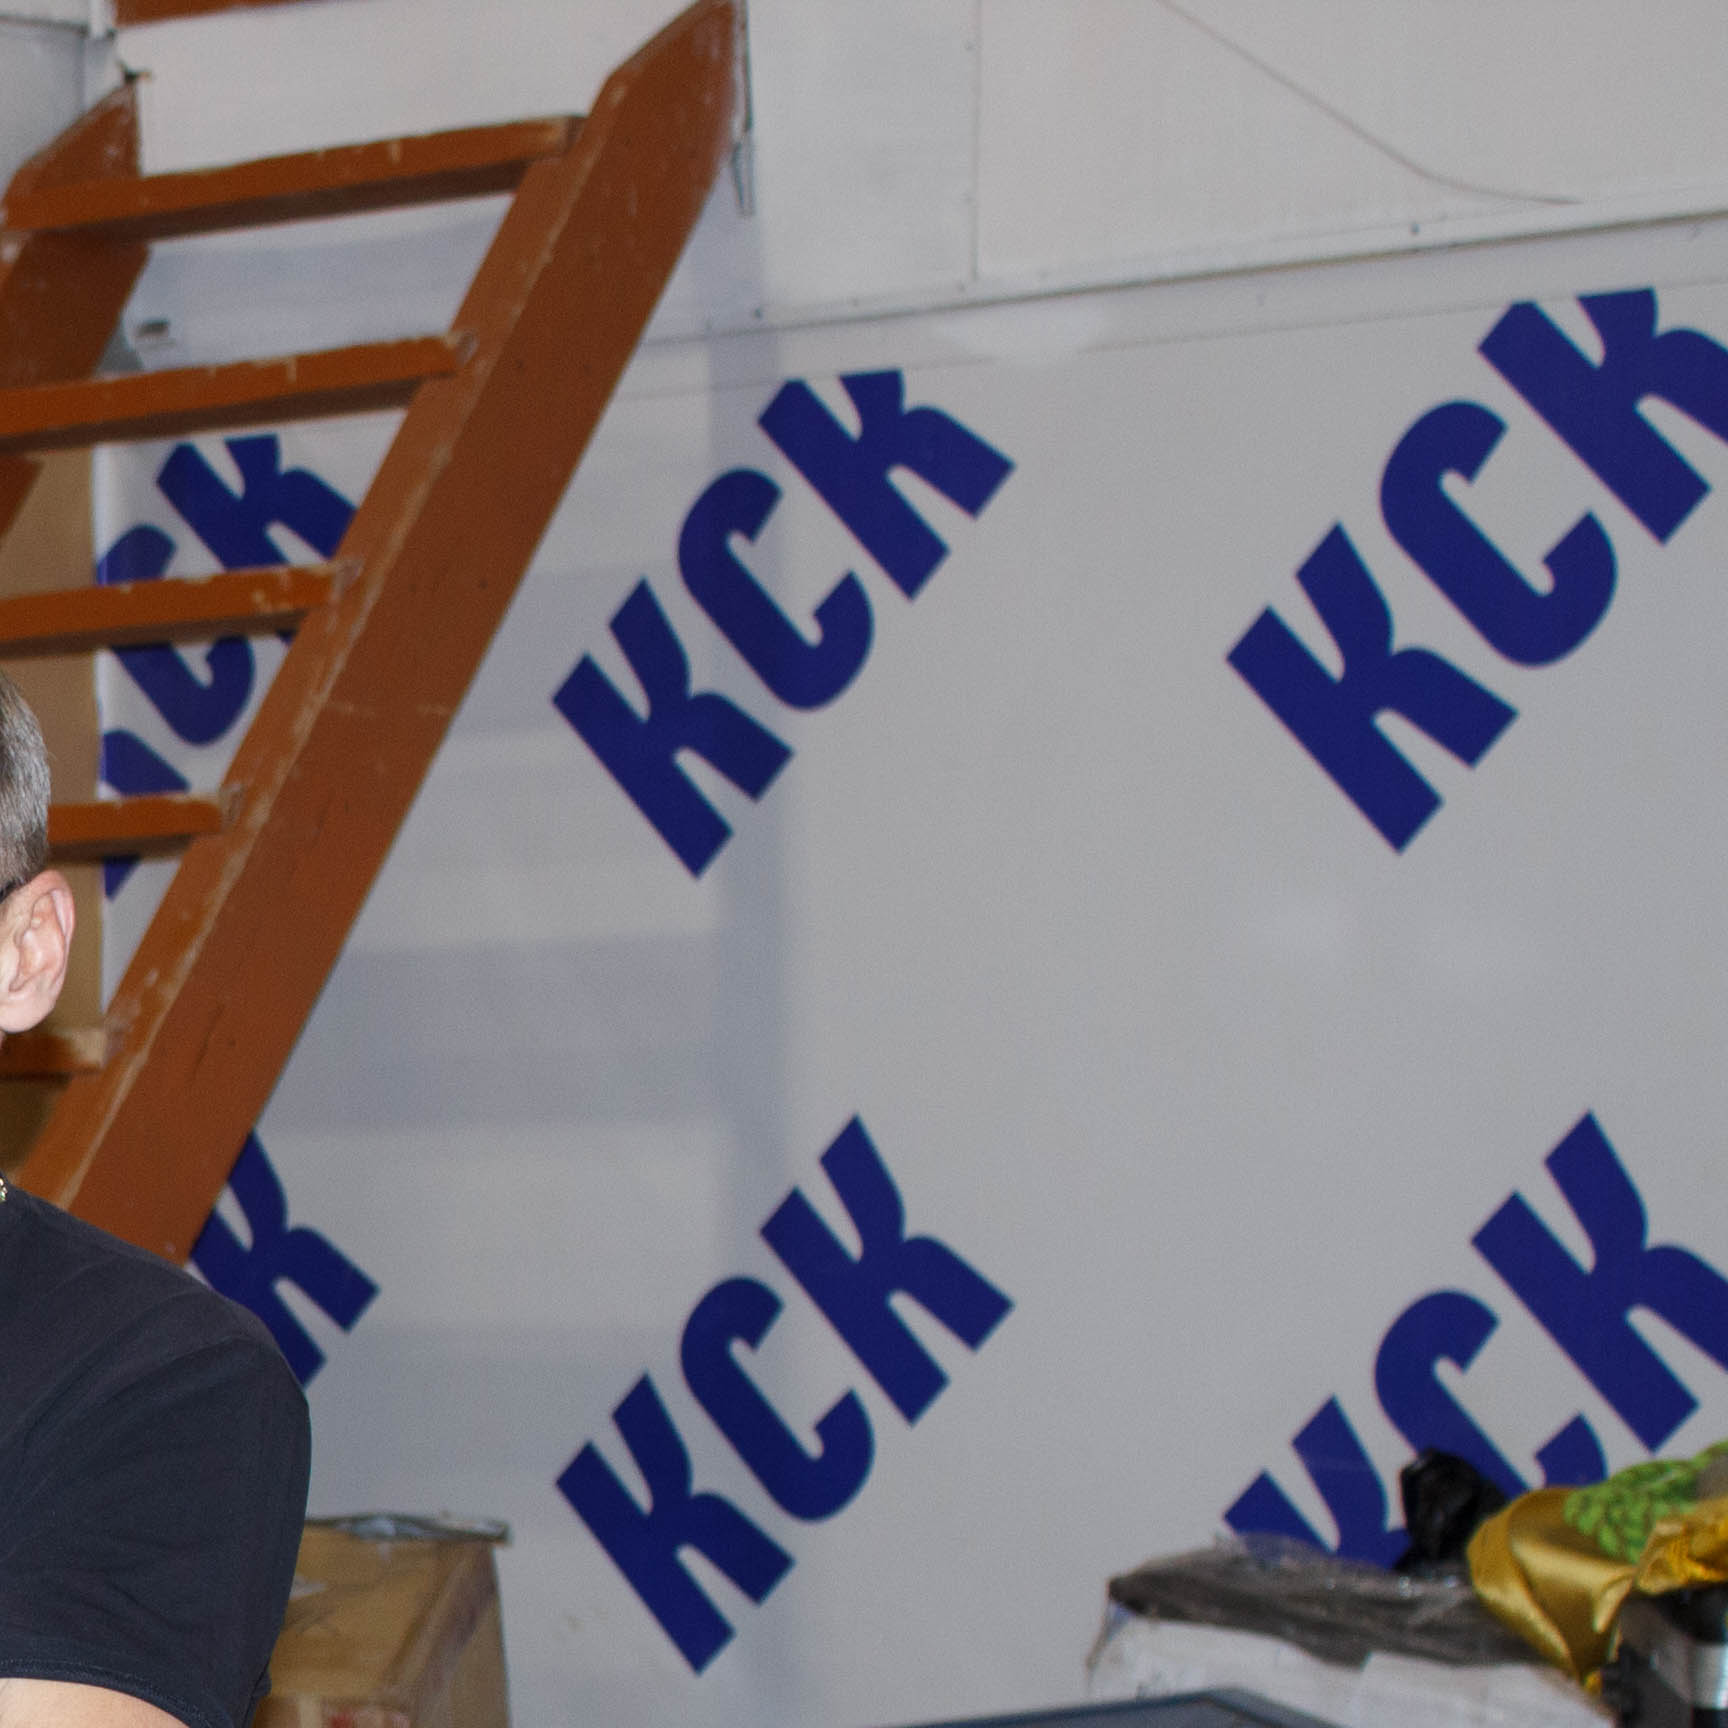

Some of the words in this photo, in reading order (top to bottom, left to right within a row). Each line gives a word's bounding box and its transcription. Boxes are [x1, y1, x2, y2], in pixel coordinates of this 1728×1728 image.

[553, 368, 1016, 878] КСК
[1224, 286, 1728, 855] КСК
[555, 1114, 1014, 1674] КСК
